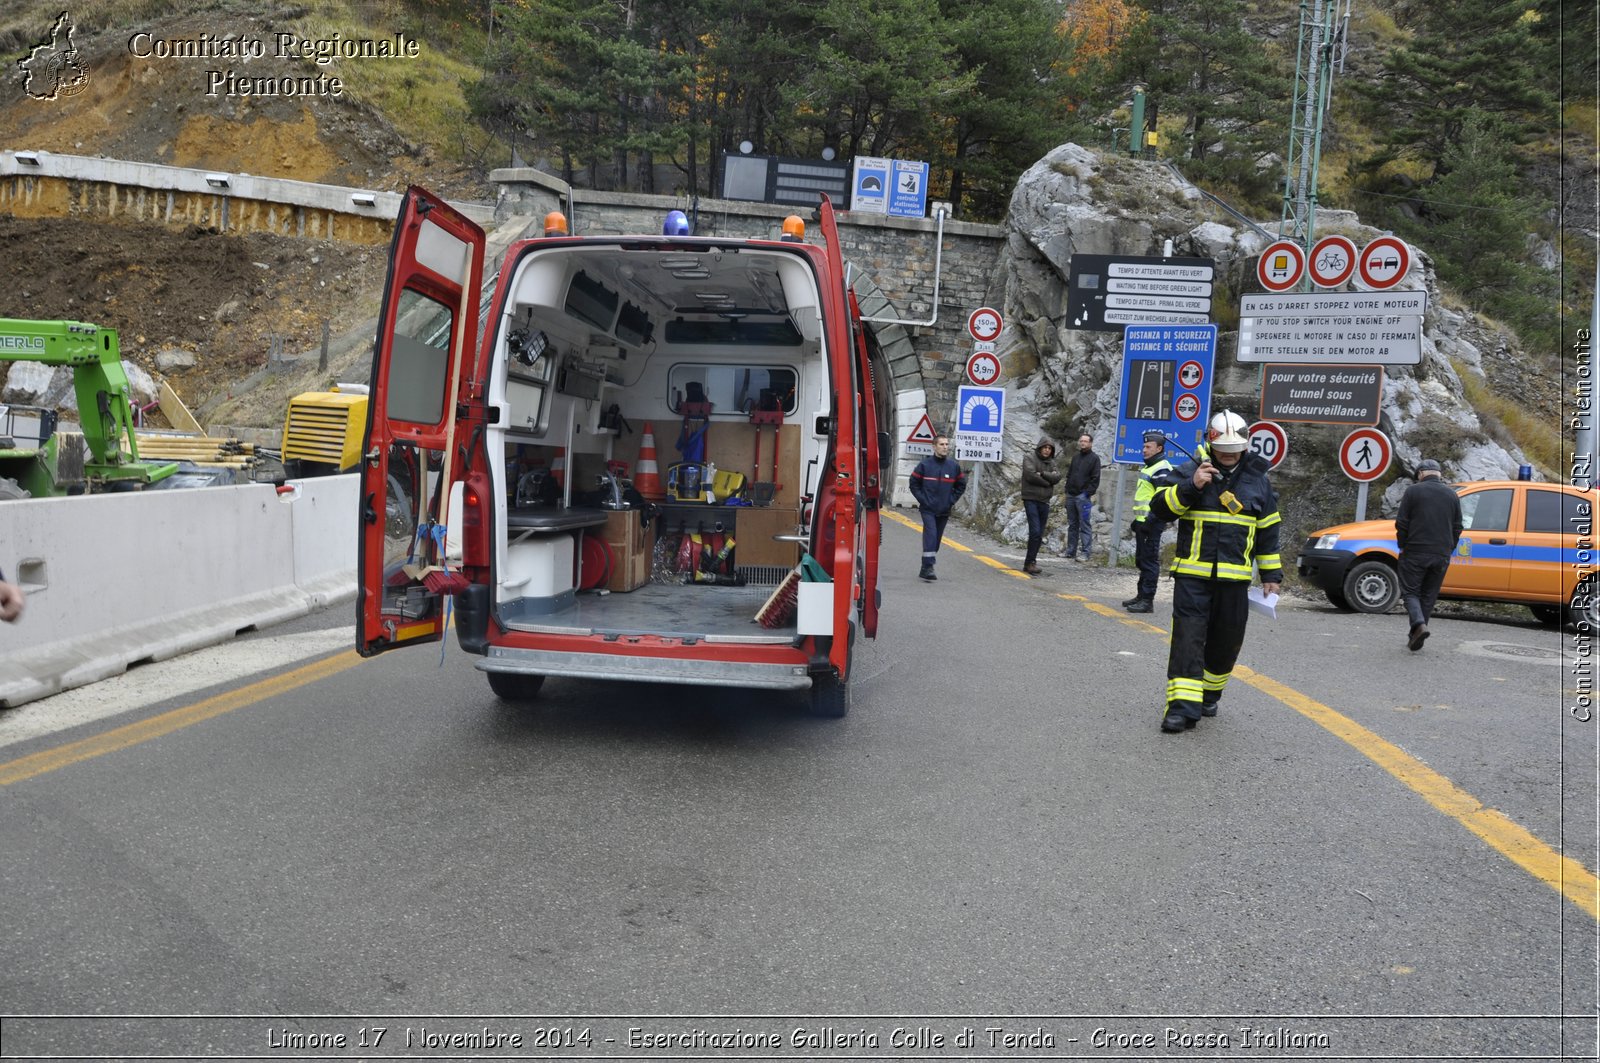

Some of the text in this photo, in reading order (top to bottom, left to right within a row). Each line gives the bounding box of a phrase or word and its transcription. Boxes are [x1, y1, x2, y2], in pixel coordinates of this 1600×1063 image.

[1130, 331, 1211, 339] DISTANZA DI SICUREZZA
[1130, 341, 1208, 351] DISTANCE DE SÉCURITÉ
[1270, 372, 1376, 384] pour votre sécurité
[1290, 388, 1352, 400] tunnel sous
[1273, 403, 1367, 417] vidéosurveillance
[1250, 437, 1276, 456] 50
